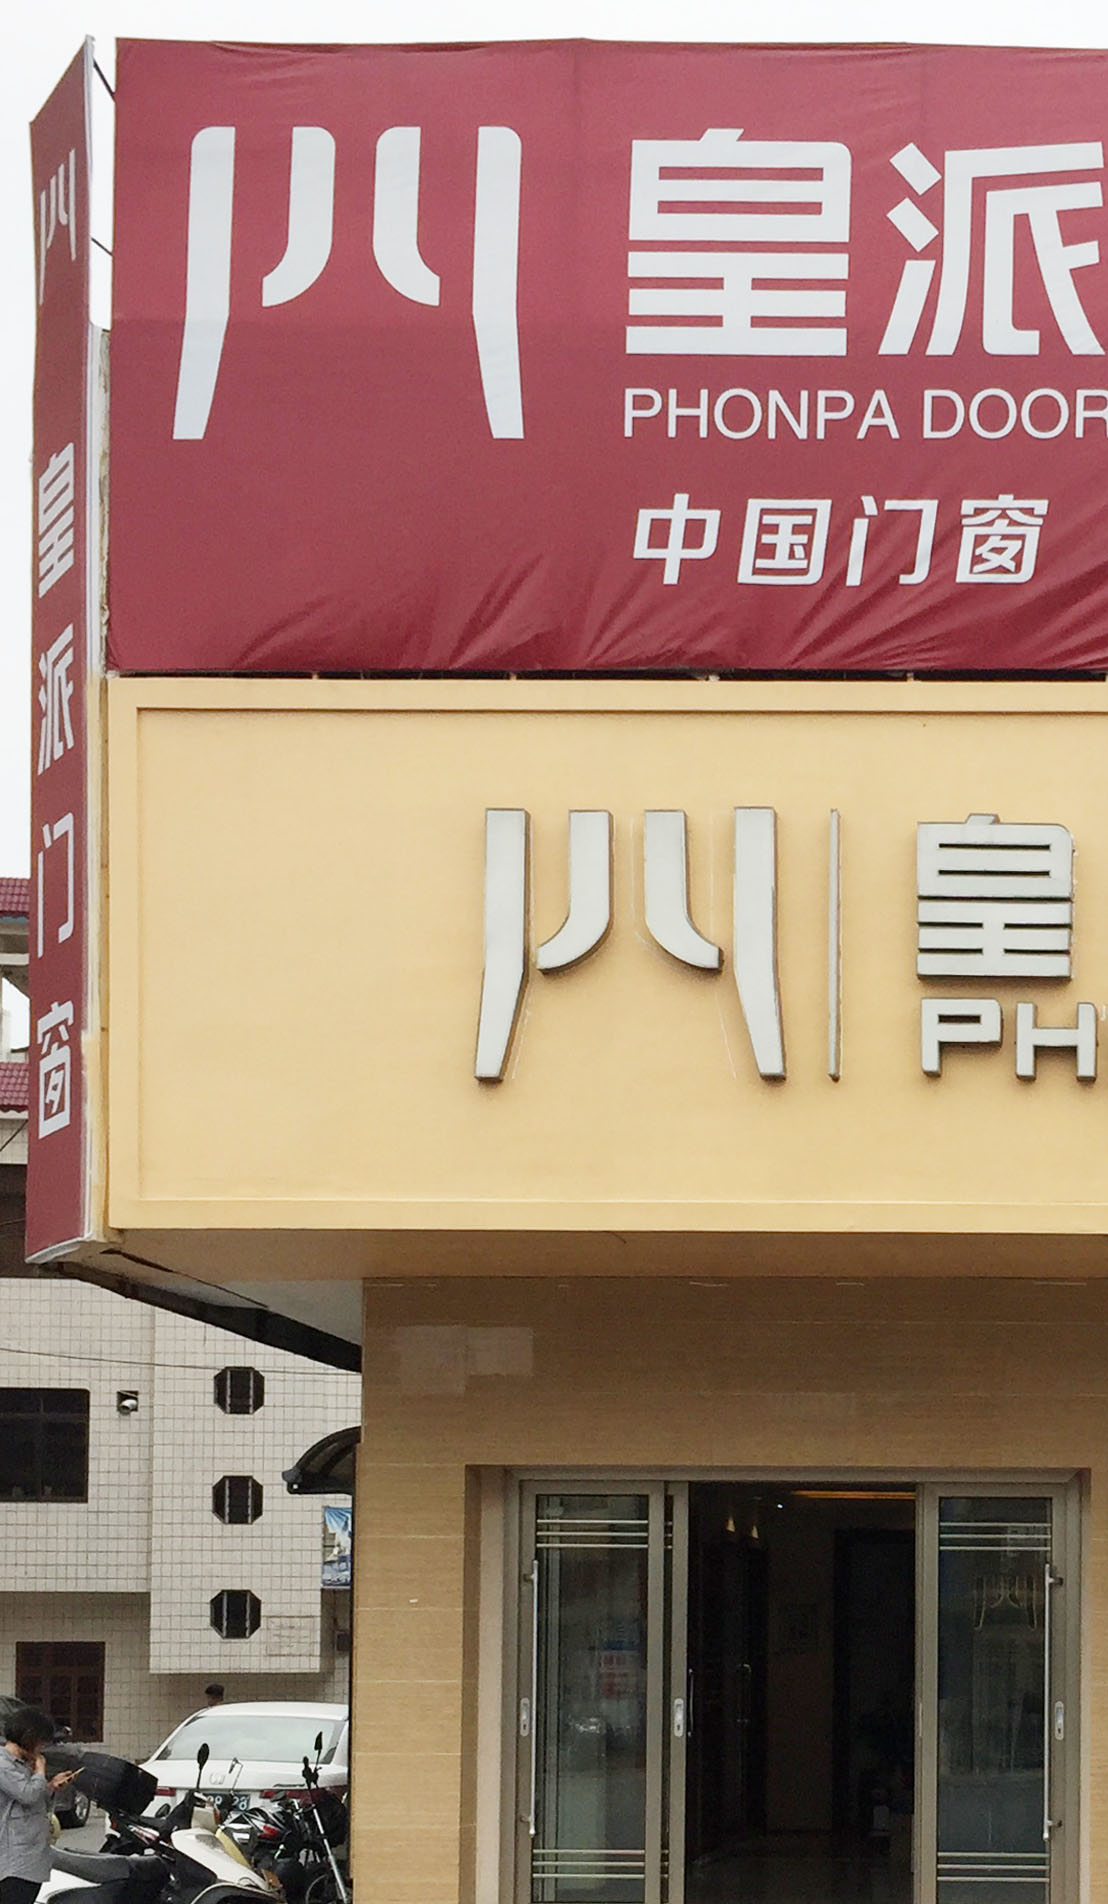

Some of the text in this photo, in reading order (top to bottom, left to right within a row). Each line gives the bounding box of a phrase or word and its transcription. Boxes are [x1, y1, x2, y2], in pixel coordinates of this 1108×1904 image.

[624, 388, 899, 439] PHONPA
[632, 493, 1049, 586] 中国门窗
